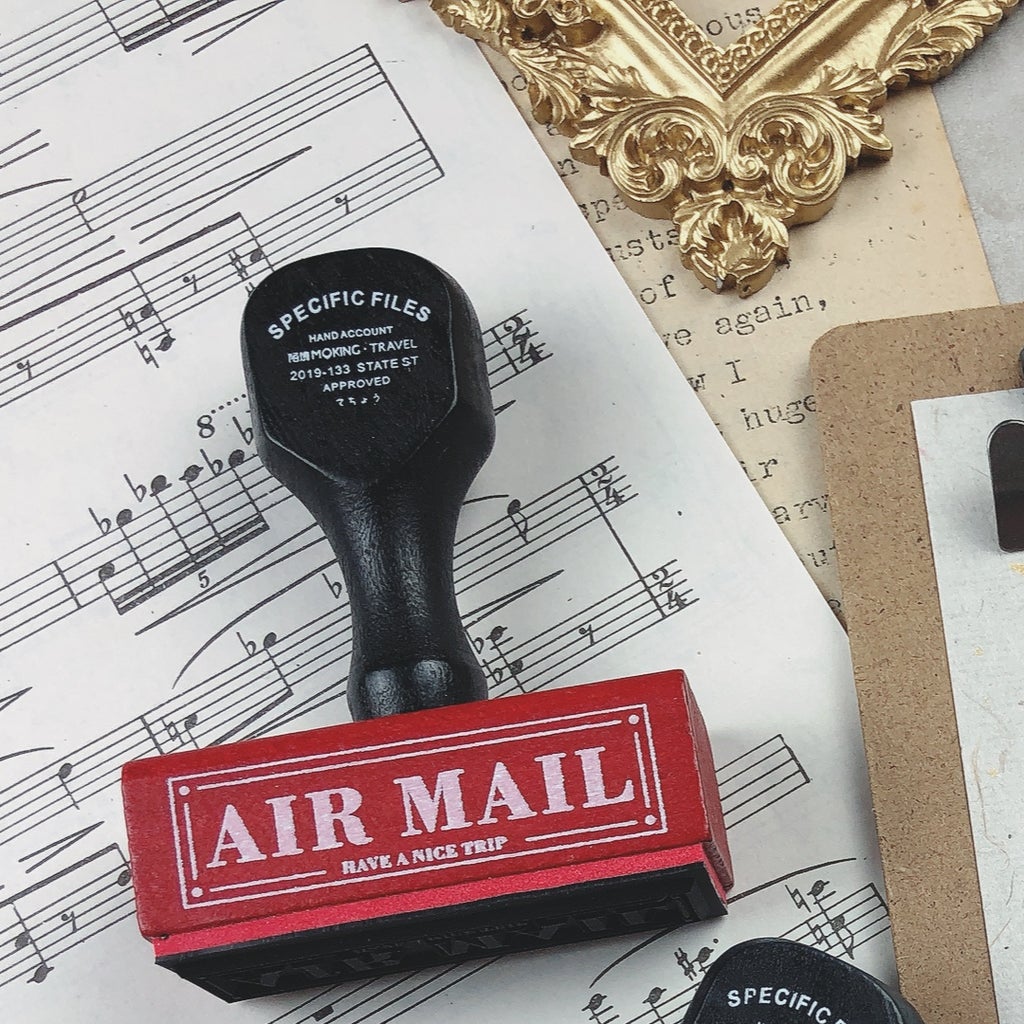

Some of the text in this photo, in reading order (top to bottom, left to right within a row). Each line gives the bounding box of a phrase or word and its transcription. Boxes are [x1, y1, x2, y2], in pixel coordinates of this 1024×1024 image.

[640, 274, 676, 305] of
[268, 290, 432, 340] SPECIFIC FILES
[714, 294, 827, 336] again,
[308, 326, 394, 343] HAND ACCOUNT
[369, 338, 418, 353] TRAVEL
[290, 356, 419, 381] 2019-133 STATE ST
[322, 375, 390, 392] APPROVED
[725, 359, 747, 385] I
[206, 746, 634, 869] AIR MAIL
[341, 836, 509, 875] HAVE A NICE TRIP
[727, 986, 832, 1024] SPECIFIC
